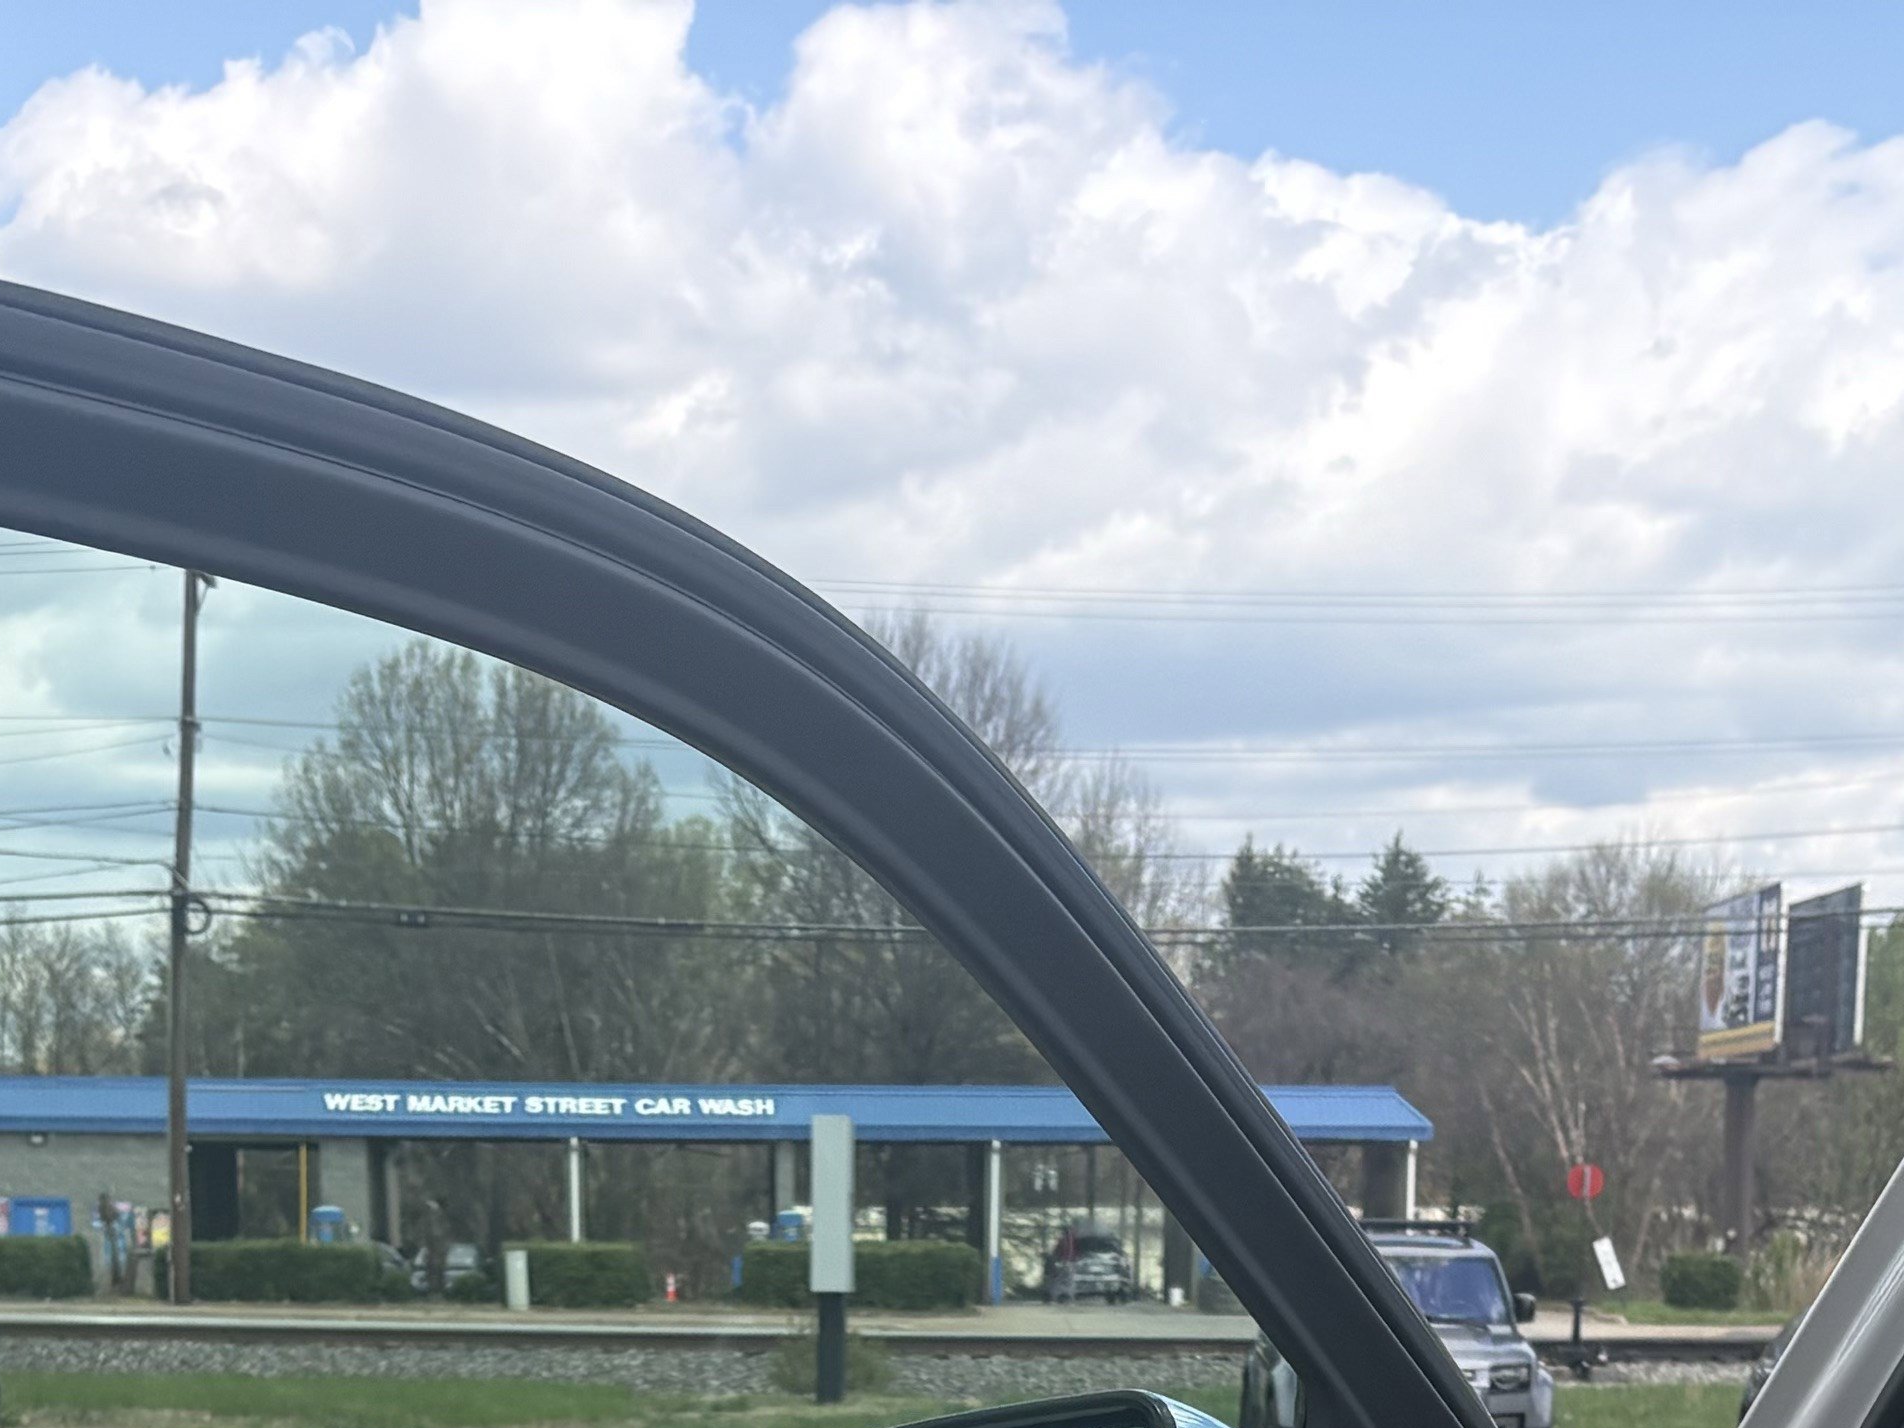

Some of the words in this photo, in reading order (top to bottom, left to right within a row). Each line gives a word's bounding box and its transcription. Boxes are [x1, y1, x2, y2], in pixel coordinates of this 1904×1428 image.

[324, 1093, 400, 1112] WEST
[406, 1094, 518, 1113] MARKET
[524, 1096, 627, 1114] STREET
[634, 1098, 692, 1115] CAR
[698, 1098, 776, 1116] WASH
